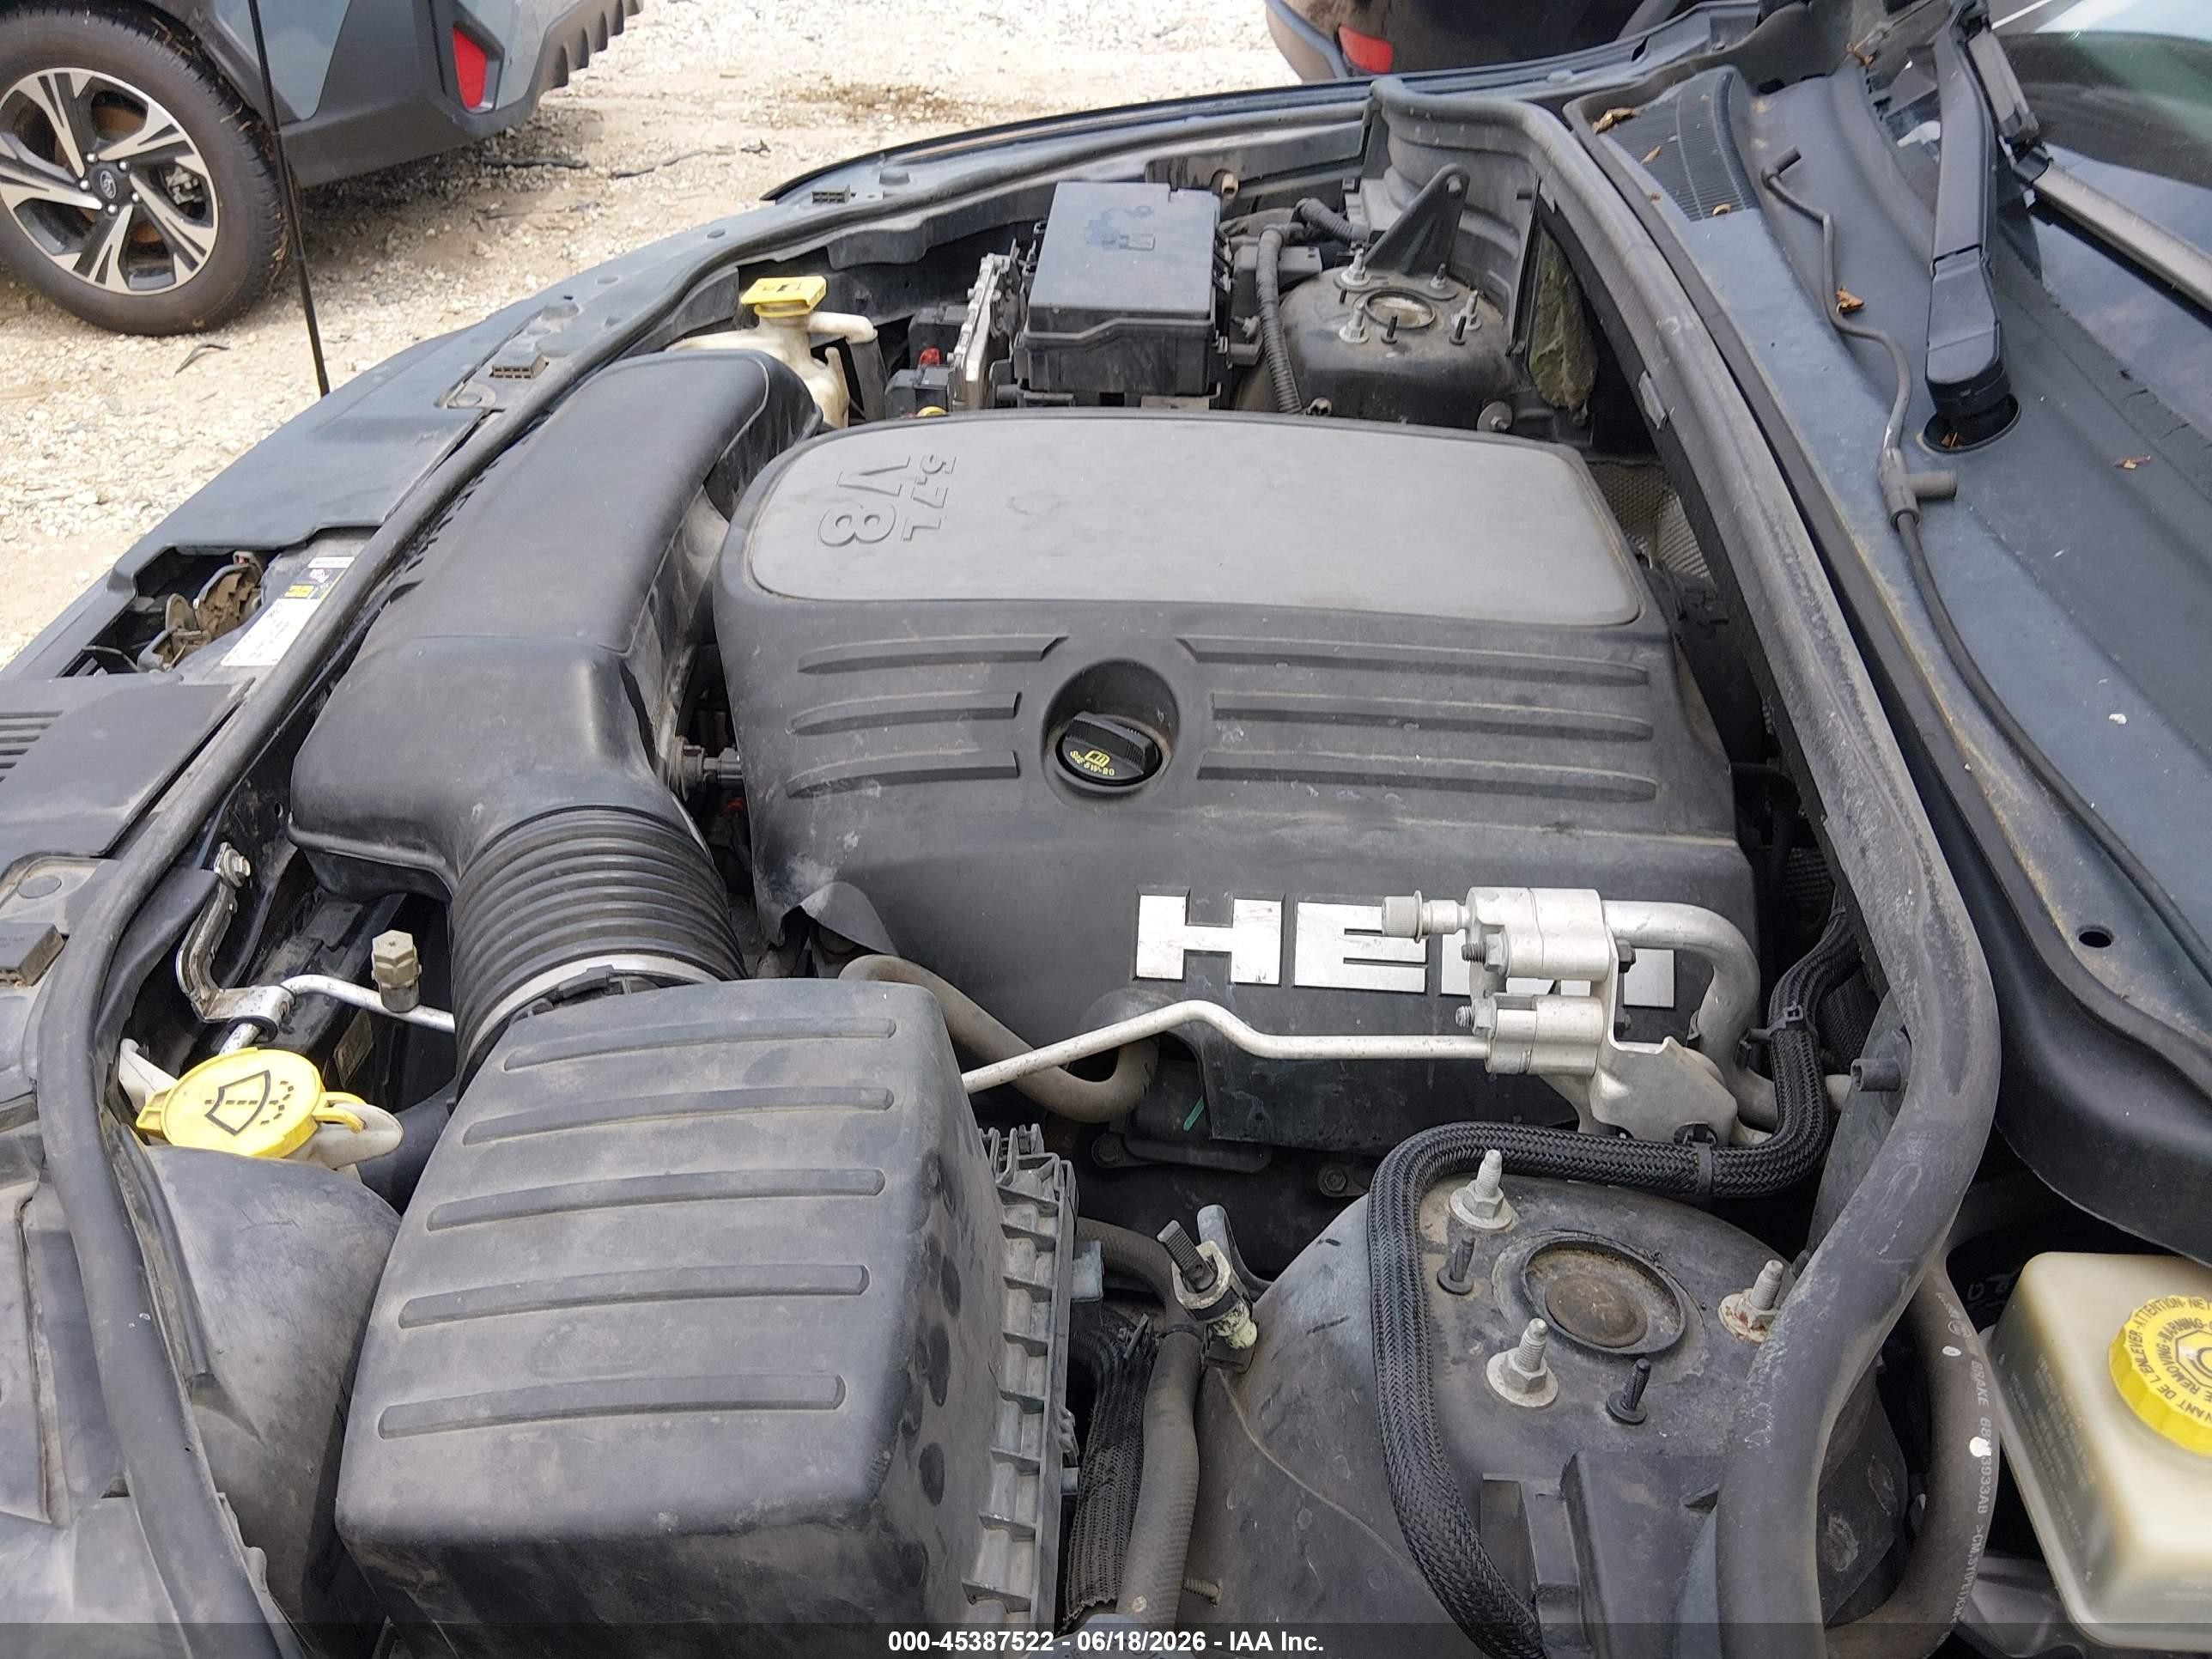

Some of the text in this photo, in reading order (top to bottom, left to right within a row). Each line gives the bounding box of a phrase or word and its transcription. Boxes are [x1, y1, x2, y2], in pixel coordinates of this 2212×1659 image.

[817, 454, 911, 548] V8
[1971, 1359, 1990, 1407] BRAKE
[1978, 1417, 1993, 1515] 683933AB
